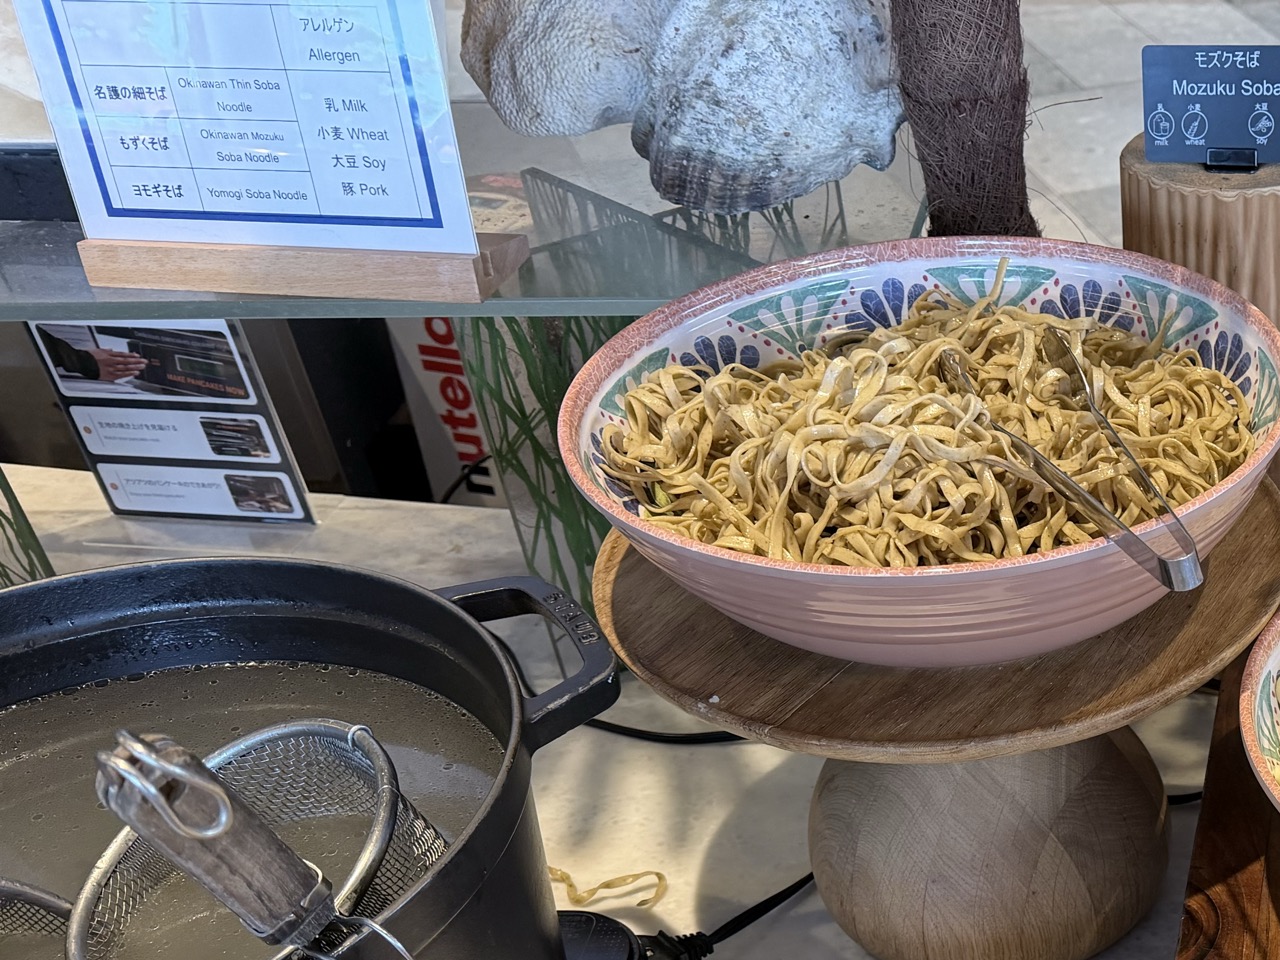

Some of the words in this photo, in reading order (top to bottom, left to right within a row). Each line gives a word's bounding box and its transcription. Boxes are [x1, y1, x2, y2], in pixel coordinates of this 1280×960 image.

[299, 18, 354, 33] アレルゲン
[308, 48, 361, 64] Allergen
[1195, 51, 1261, 69] モズクそば
[178, 77, 227, 90] Okinawan
[229, 79, 250, 90] Thin
[254, 80, 281, 91] Soba
[1173, 80, 1235, 96] Mozuku
[94, 85, 168, 101] 名護の細そば
[217, 101, 252, 112] Noodle
[324, 97, 339, 113] 乳
[342, 99, 368, 113] Milk
[200, 129, 249, 141] Okinawan
[251, 132, 285, 142] Mozuku
[317, 126, 345, 141] 小麦
[347, 128, 389, 141] Wheat
[119, 136, 170, 150] もずくそば
[1256, 138, 1268, 146] soy
[217, 152, 242, 162] Soba
[245, 153, 279, 163] Noodle
[331, 154, 359, 169] 大豆
[363, 156, 387, 171] Soy
[132, 184, 184, 198] ヨモギそば
[207, 187, 243, 200] Yomogi
[246, 189, 271, 200] Soba
[273, 190, 308, 201] Noodle
[342, 182, 356, 196] 豚
[361, 183, 389, 197] Pork
[166, 374, 186, 384] MAKE
[225, 386, 245, 396] NOW
